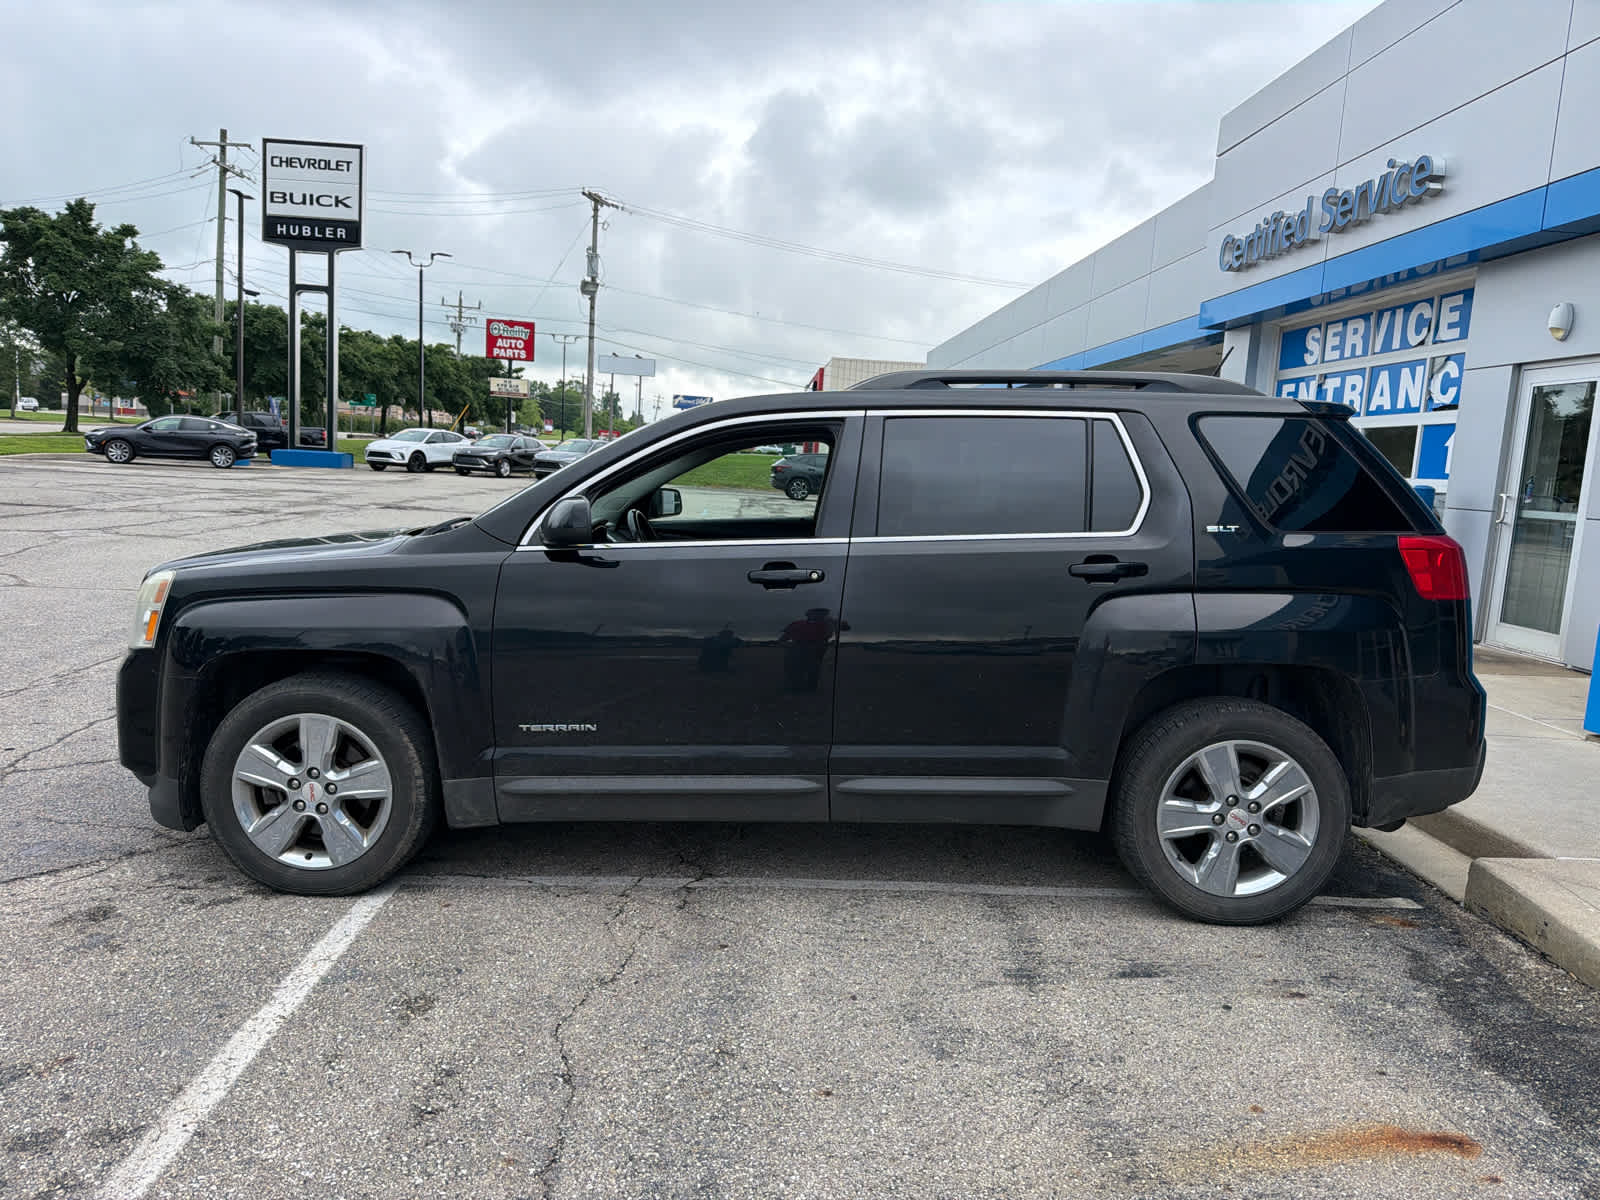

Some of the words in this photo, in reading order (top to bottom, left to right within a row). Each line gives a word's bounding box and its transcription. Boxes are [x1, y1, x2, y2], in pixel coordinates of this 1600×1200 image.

[270, 155, 353, 172] CHEVROLET
[269, 191, 353, 208] BUICK
[1219, 196, 1318, 272] Certified
[1318, 155, 1436, 234] Service
[276, 223, 346, 239] HUBLER
[490, 322, 530, 340] O'Reilly
[1303, 294, 1464, 365] SERVICE
[496, 339, 525, 349] AUTO
[493, 348, 527, 359] PARTS
[518, 724, 597, 732] TERRAIN
